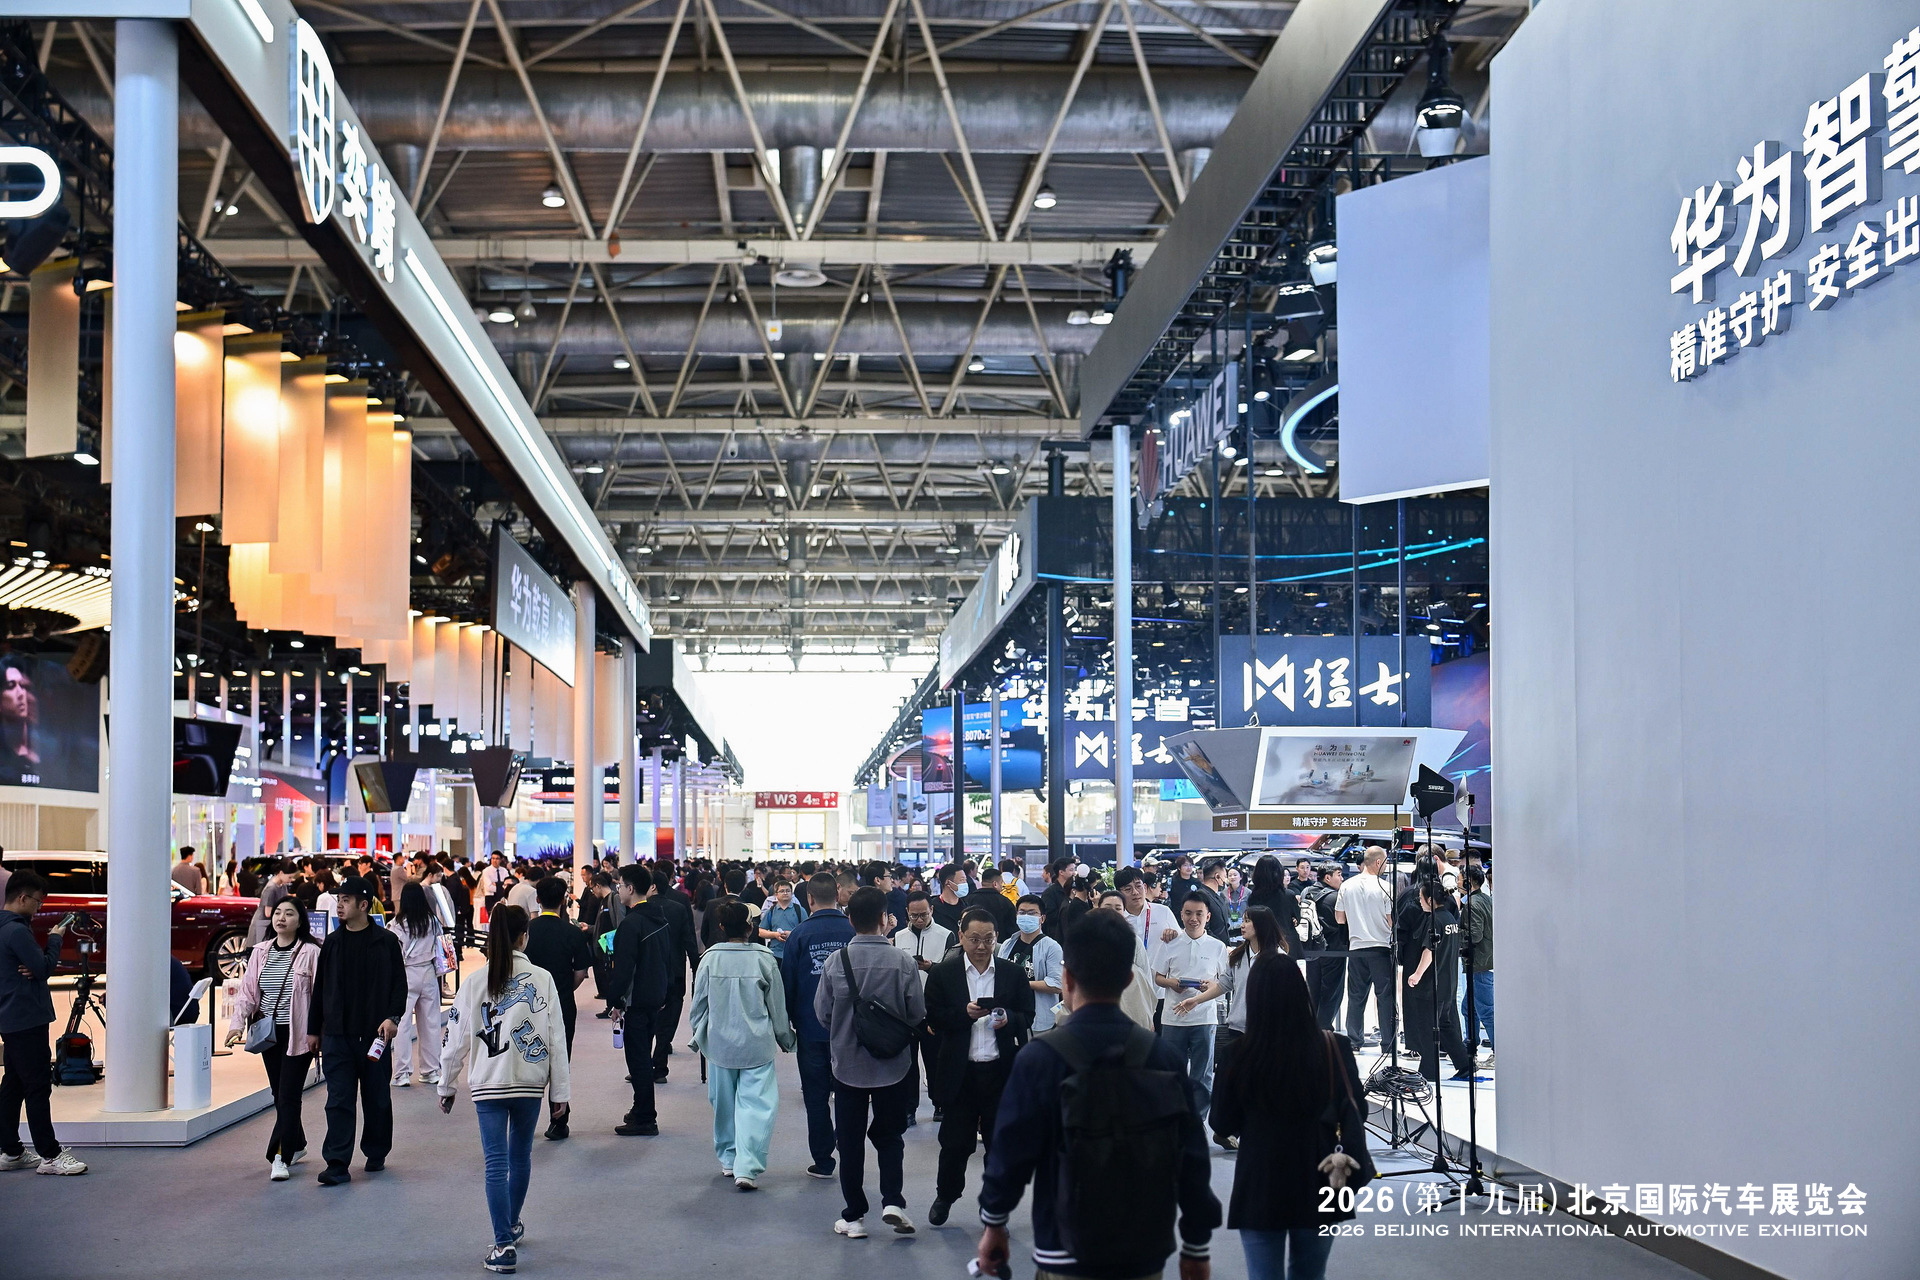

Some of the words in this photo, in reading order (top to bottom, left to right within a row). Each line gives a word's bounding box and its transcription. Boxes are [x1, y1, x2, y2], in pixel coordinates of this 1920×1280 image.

[1669, 268, 1793, 382] 精准守护
[1163, 363, 1236, 491] HUAWEI
[774, 793, 798, 806] W3
[1292, 817, 1328, 827] 精准守护
[1332, 817, 1367, 827] 安全出行
[821, 941, 843, 949] STRAUSS
